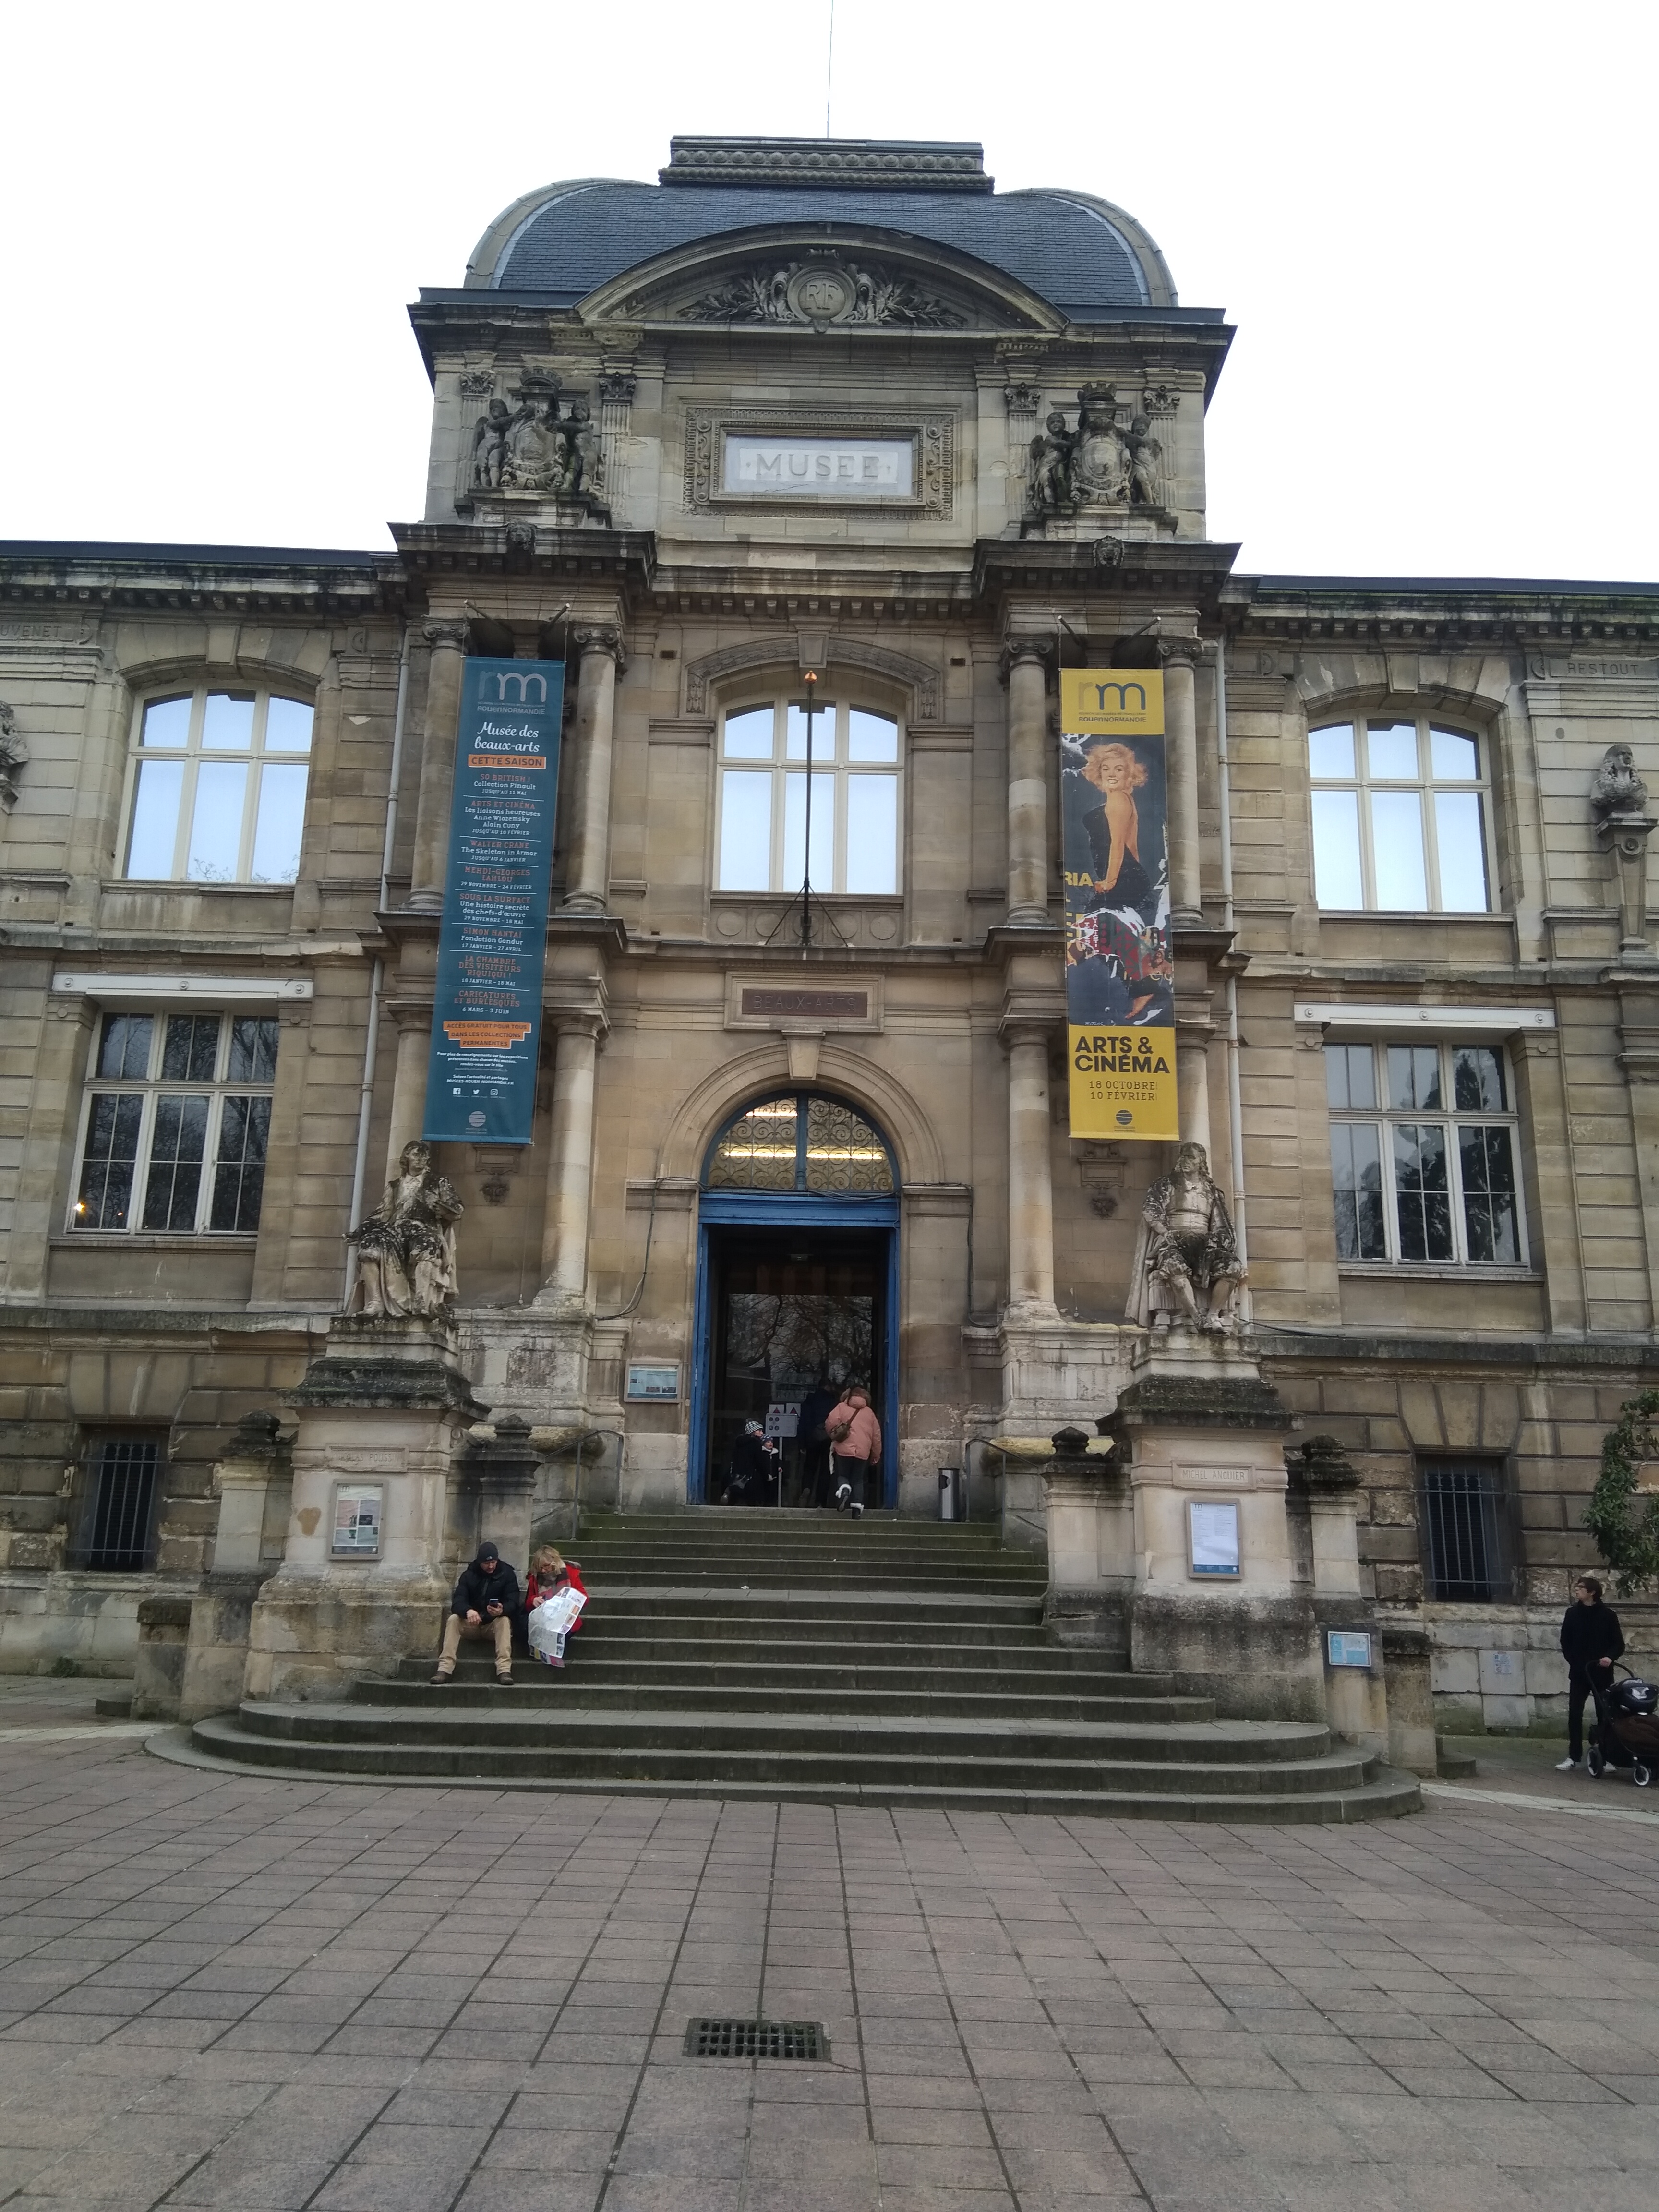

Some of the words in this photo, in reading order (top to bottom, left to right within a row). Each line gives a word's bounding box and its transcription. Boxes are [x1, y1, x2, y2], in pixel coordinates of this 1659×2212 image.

[756, 454, 880, 478] MUSEE
[1567, 663, 1638, 675] RESTOUT
[477, 721, 517, 736] Musée
[519, 725, 539, 738] des
[474, 736, 540, 753] beaux-arts
[471, 757, 503, 765] CETTE
[505, 758, 542, 767] SAISON
[510, 782, 536, 790] Pinault
[505, 801, 535, 809] CINÉMA
[465, 866, 530, 876] MEHDI-GEORGES
[464, 927, 490, 936] SIMON
[476, 956, 515, 964] CHAMBRE
[476, 963, 521, 972] VISITEURS
[467, 969, 506, 978] RIQUIQUI
[459, 990, 516, 999] CARICATURES
[466, 998, 520, 1007] BURLESQUES
[753, 995, 856, 1011] BEAUX-ARTS
[1075, 1036, 1132, 1054] ARTS
[1138, 1036, 1154, 1054] &
[1075, 1053, 1170, 1074] CINÉMA
[1089, 1081, 1101, 1089] 18
[1106, 1081, 1154, 1090] OCTOBRE
[1091, 1091, 1103, 1100] 10
[1107, 1090, 1154, 1101] FÉVRIER
[1182, 1470, 1207, 1479] MICHEL
